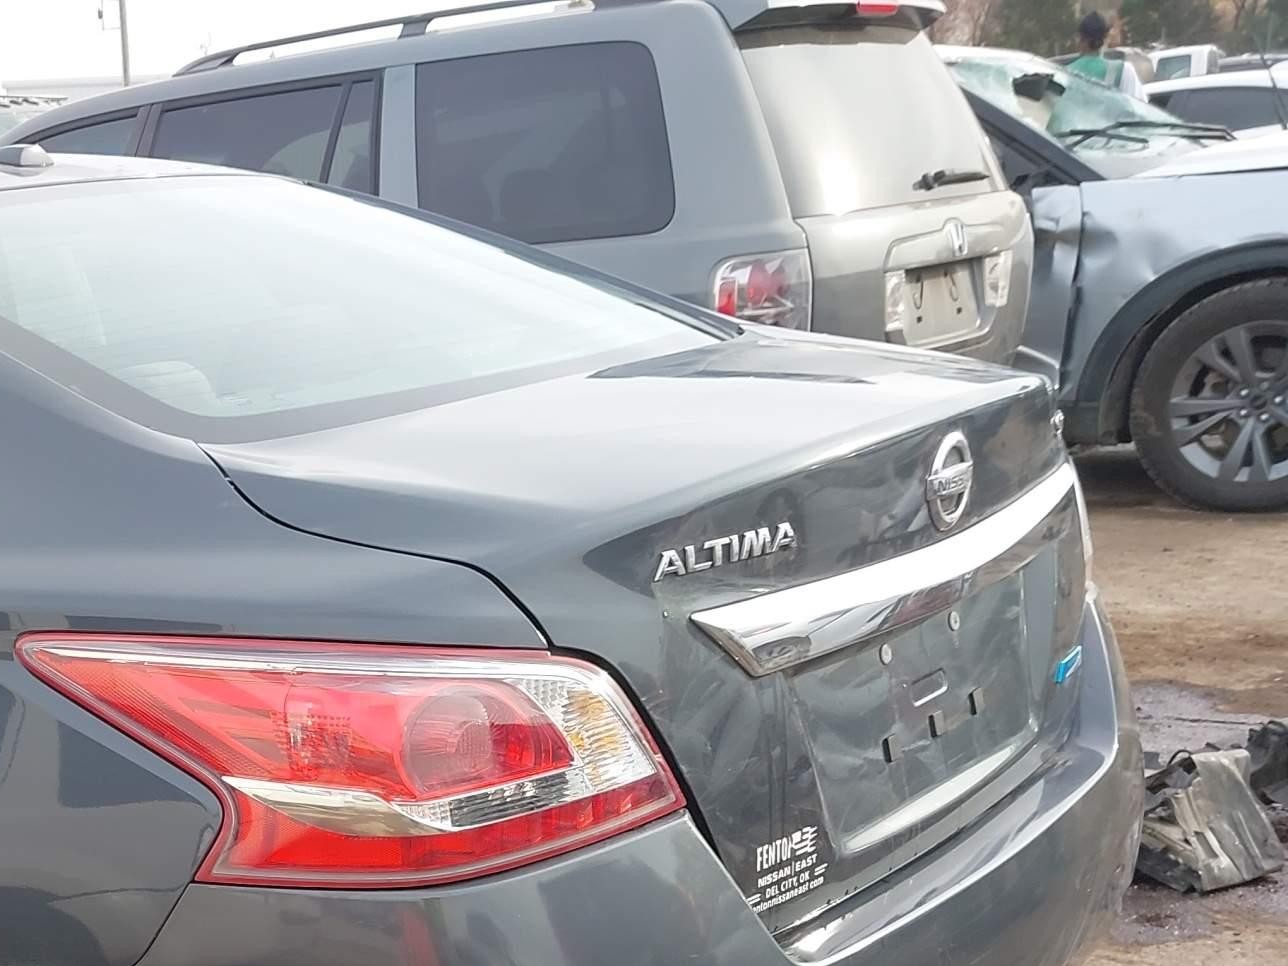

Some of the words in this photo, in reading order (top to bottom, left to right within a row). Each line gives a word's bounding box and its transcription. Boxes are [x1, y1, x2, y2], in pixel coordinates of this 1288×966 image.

[653, 521, 798, 582] ALTIMA
[758, 866, 791, 888] NISSAN
[795, 853, 818, 872] EAST
[765, 884, 779, 899] DEL
[799, 870, 811, 883] OK
[752, 876, 824, 913] entonnissaneast.com
